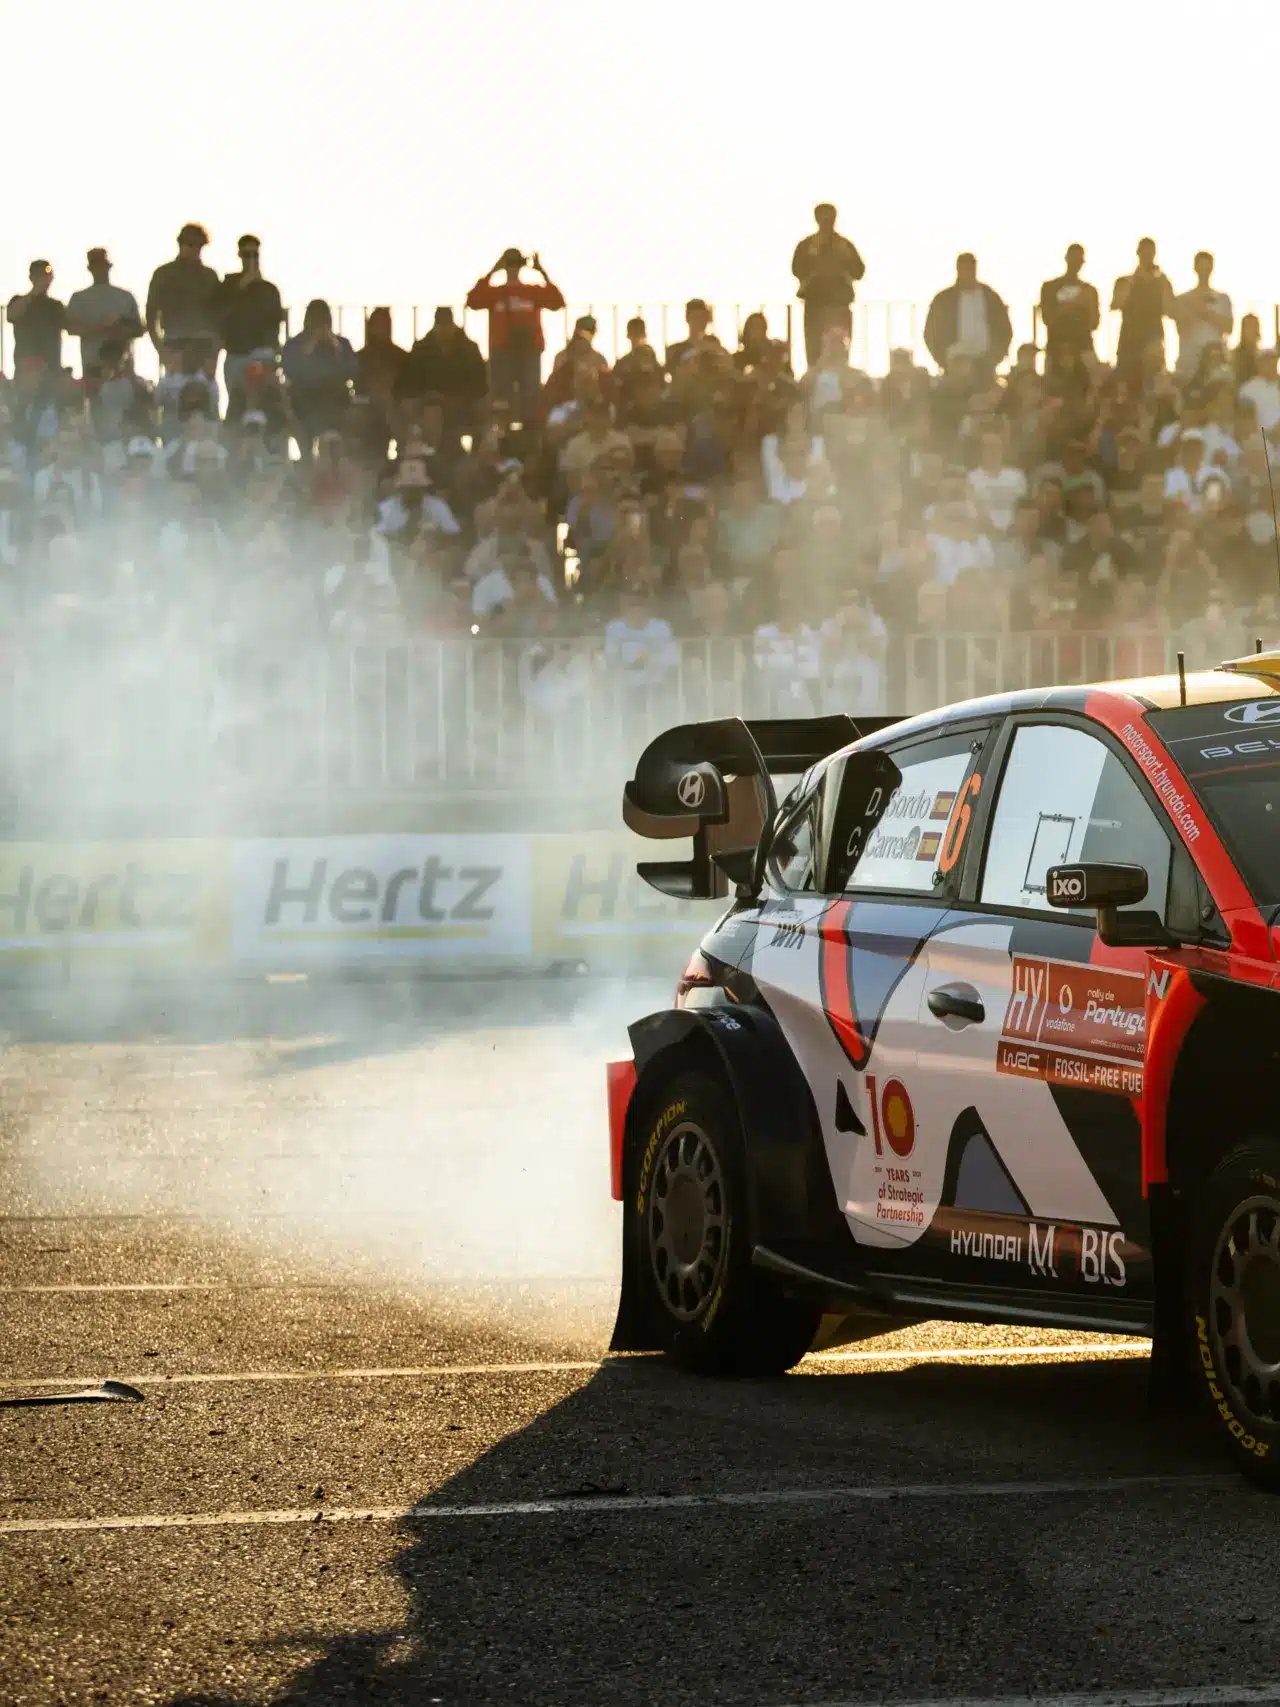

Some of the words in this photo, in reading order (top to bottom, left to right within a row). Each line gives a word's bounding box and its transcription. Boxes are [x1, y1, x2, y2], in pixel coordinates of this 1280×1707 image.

[1120, 723, 1200, 841] motorsport.hyundai.com
[865, 787, 881, 817] D.
[940, 772, 981, 873] 6
[846, 826, 862, 857] C.
[264, 855, 504, 925] Hertz
[1052, 871, 1082, 896] ixo
[1105, 990, 1115, 1001] de
[1046, 1018, 1075, 1032] vodafone
[1083, 1000, 1146, 1036] Portuga
[1003, 1049, 1040, 1073] WRC
[1055, 1058, 1120, 1090] FOSSIL-FREE
[886, 1168, 910, 1183] YEARS
[878, 1182, 887, 1199] of
[888, 1185, 924, 1206] Strategic
[876, 1202, 924, 1225] Partnership
[950, 1229, 1022, 1262] HYUNDAI
[1028, 1223, 1127, 1287] MOBIS
[1196, 1314, 1269, 1457] SCORPION
